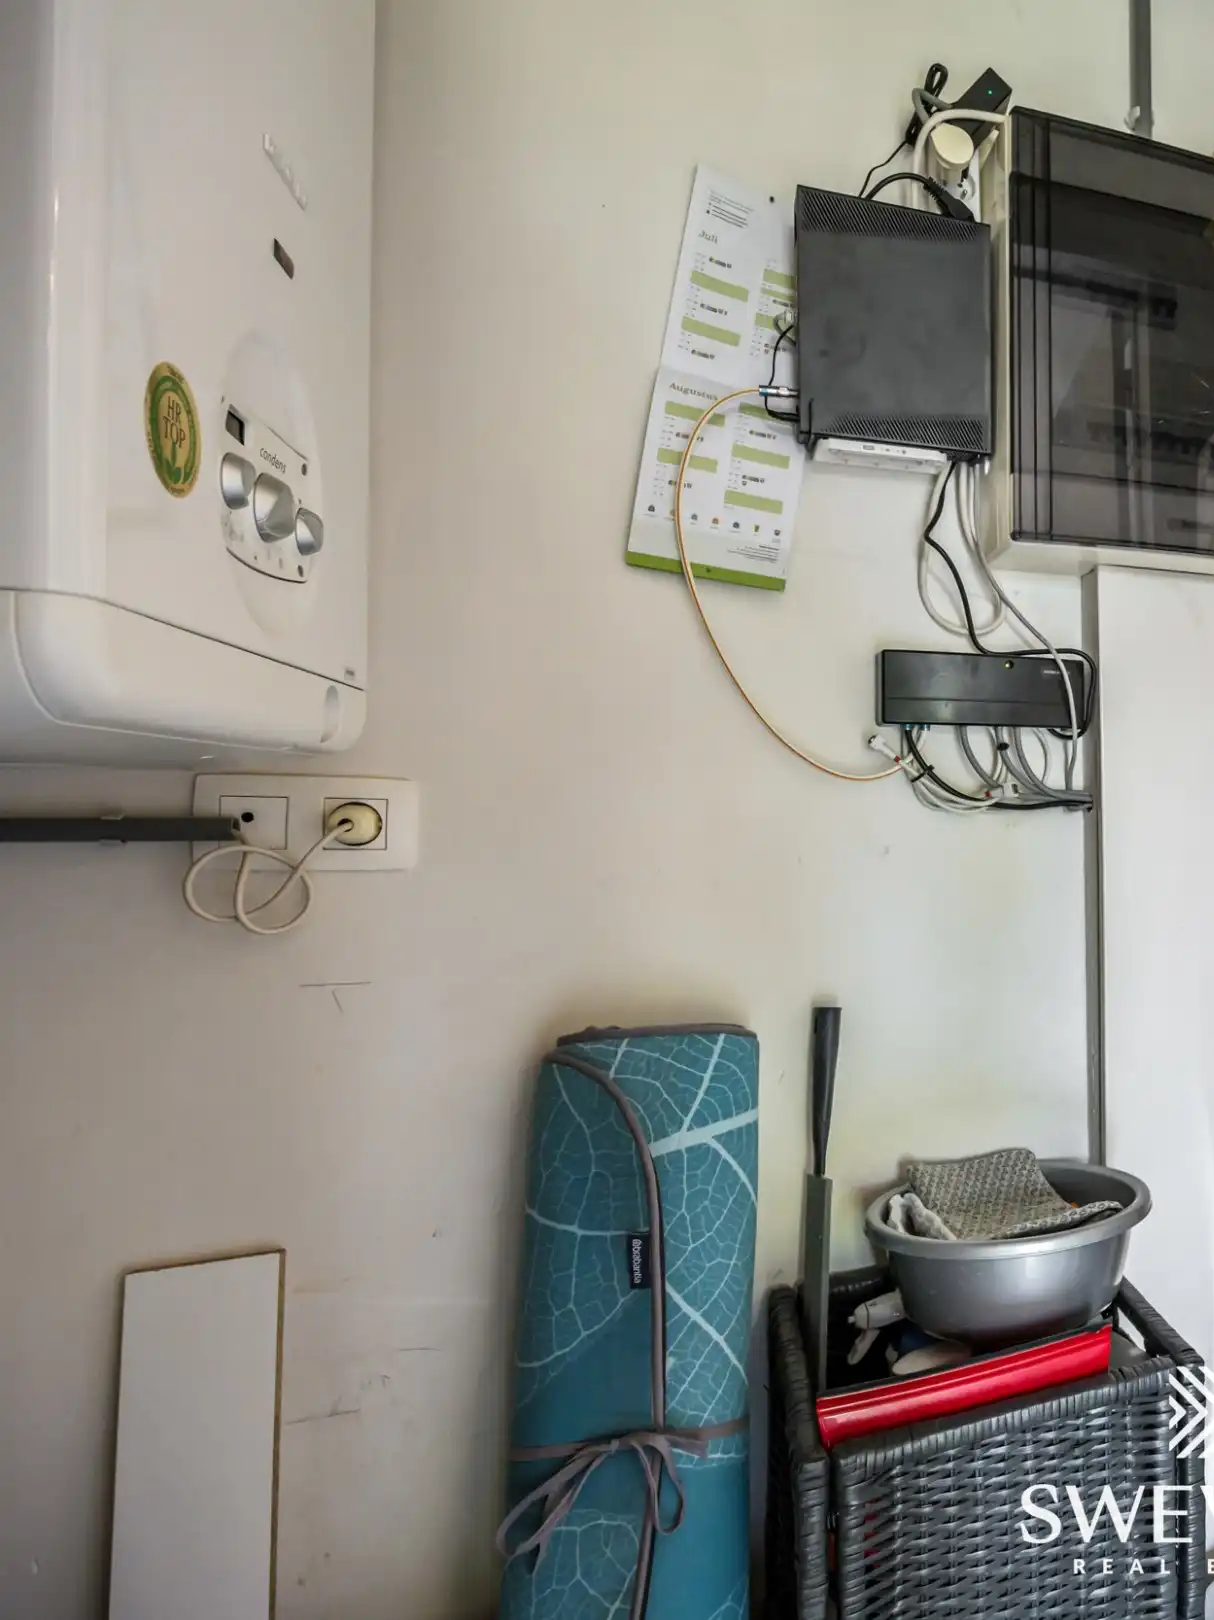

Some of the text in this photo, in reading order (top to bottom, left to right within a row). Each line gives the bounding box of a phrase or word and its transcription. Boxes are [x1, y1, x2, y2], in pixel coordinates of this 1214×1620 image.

[698, 229, 718, 244] Juli
[669, 382, 719, 402] Augustus
[167, 395, 182, 422] HR
[163, 415, 187, 449] TOP
[259, 447, 287, 475] condens
